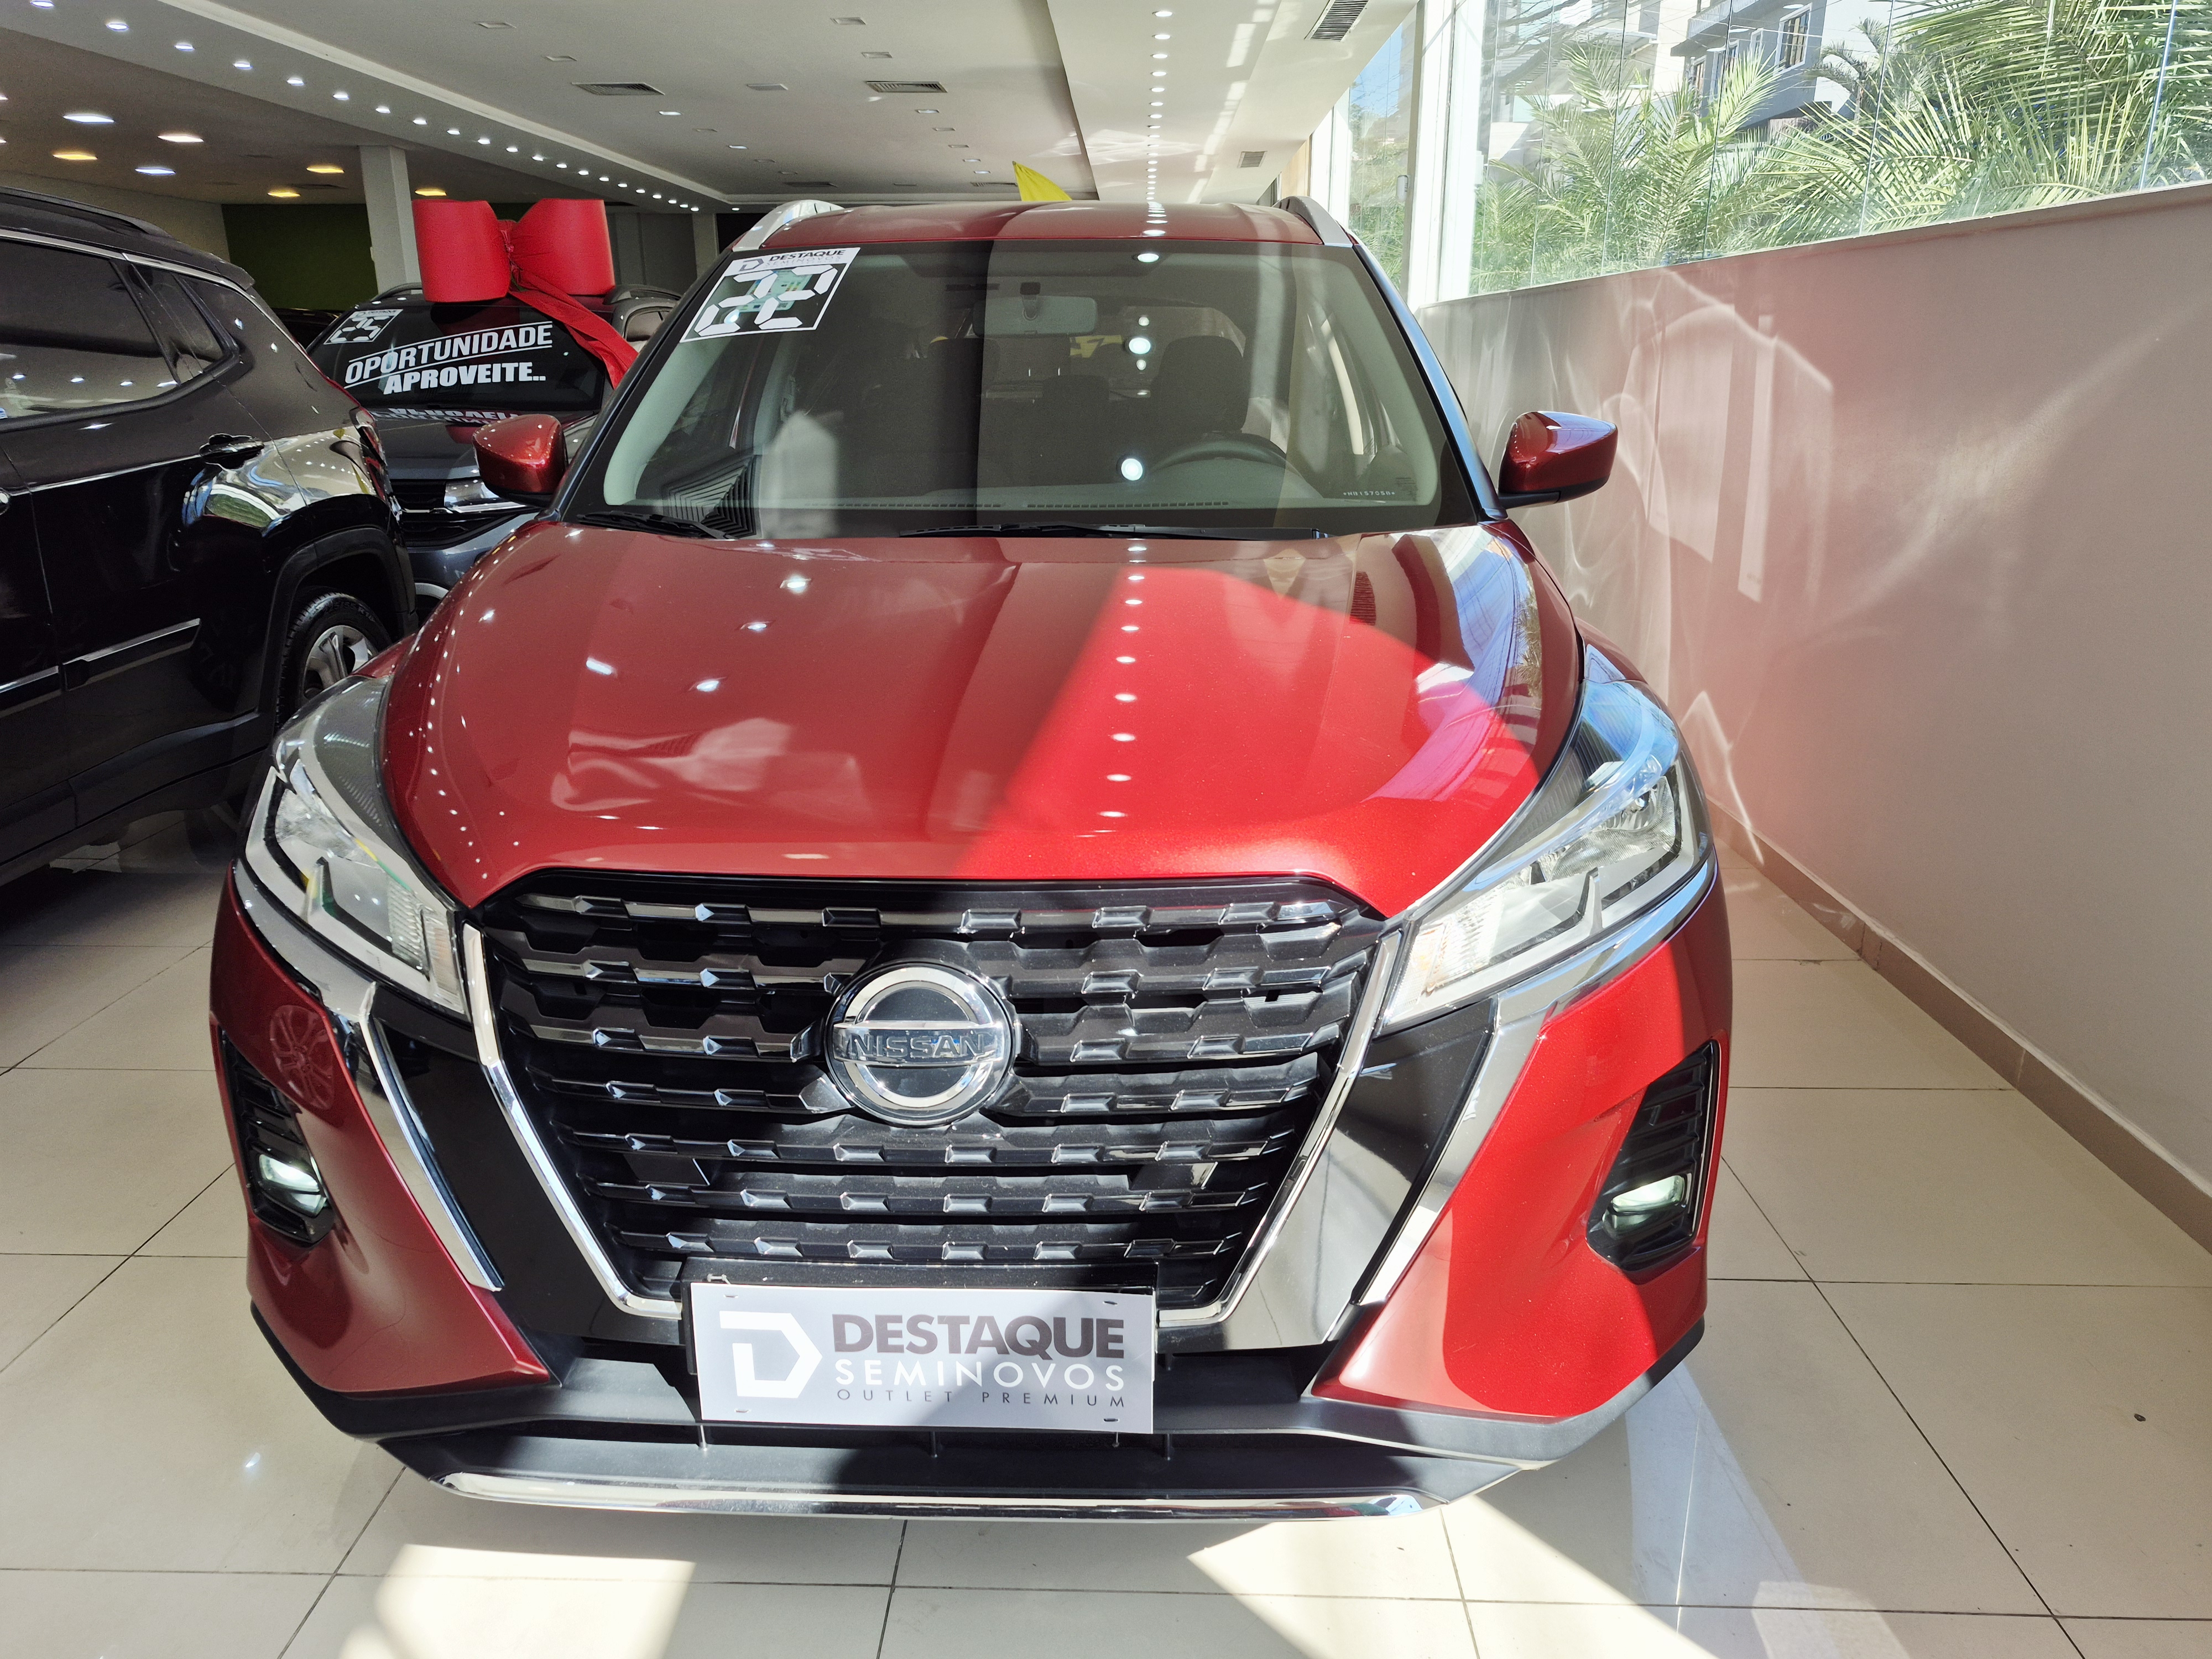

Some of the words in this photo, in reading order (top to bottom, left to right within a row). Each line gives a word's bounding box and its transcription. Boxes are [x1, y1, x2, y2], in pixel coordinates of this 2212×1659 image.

[769, 250, 846, 261] DESTAQUE
[694, 264, 838, 336] 22
[330, 316, 390, 342] 25
[345, 324, 552, 384] OPORTUNIDADE
[848, 1032, 985, 1058] NISSAN
[832, 1313, 1124, 1360] DESTAQUE
[835, 1359, 1124, 1391] SEMINOVOS
[837, 1389, 953, 1403] OUTLET
[982, 1391, 1124, 1408] PREMIUM
